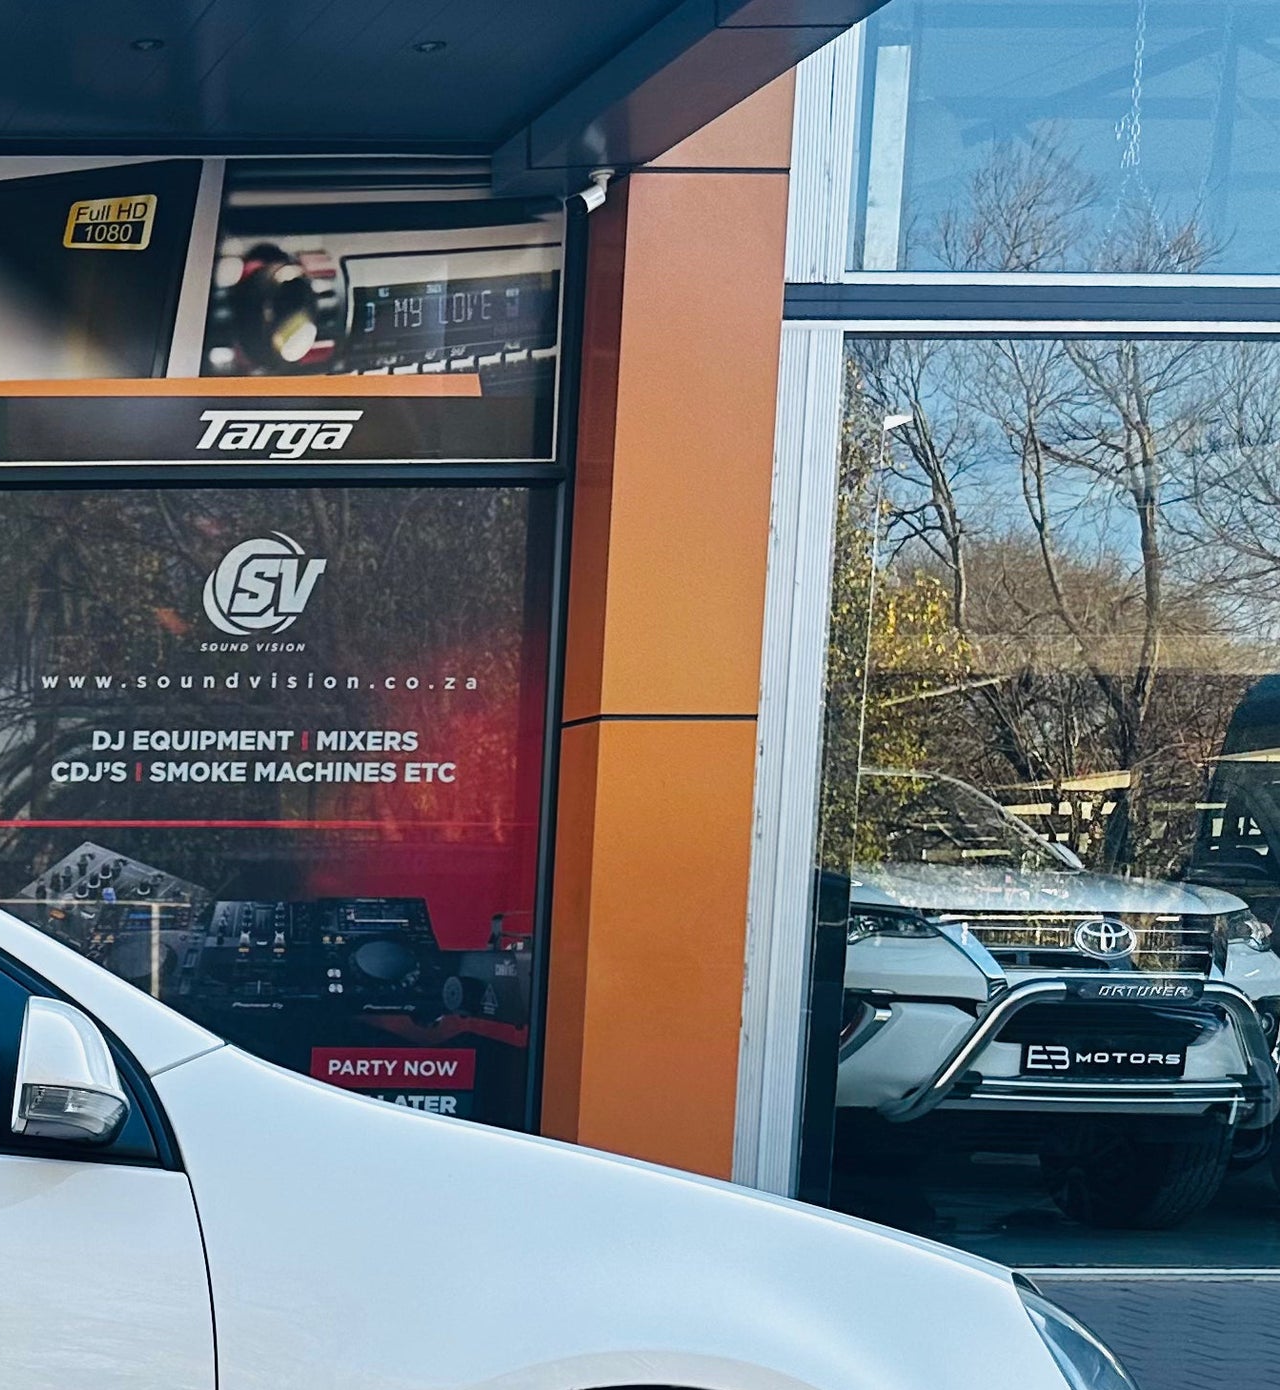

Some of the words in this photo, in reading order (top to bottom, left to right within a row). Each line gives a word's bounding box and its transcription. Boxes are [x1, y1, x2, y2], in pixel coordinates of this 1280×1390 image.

[75, 204, 111, 221] Full
[117, 202, 148, 220] HD
[84, 224, 132, 242] 1080
[196, 410, 364, 459] Targa
[230, 558, 326, 613] SV
[200, 643, 248, 651] SOUND
[257, 643, 305, 652] VISION
[42, 673, 476, 689] www.soundvision.co.za
[92, 731, 125, 750] DJ
[133, 731, 294, 750] EQUIPMENT
[317, 731, 418, 751] MIXERS
[150, 762, 247, 782] SMOKE
[255, 762, 396, 782] MACHINES
[405, 763, 456, 782] ETC
[1076, 1053, 1180, 1064] MOTORS
[329, 1060, 397, 1075] PARTY
[404, 1061, 457, 1076] NOW
